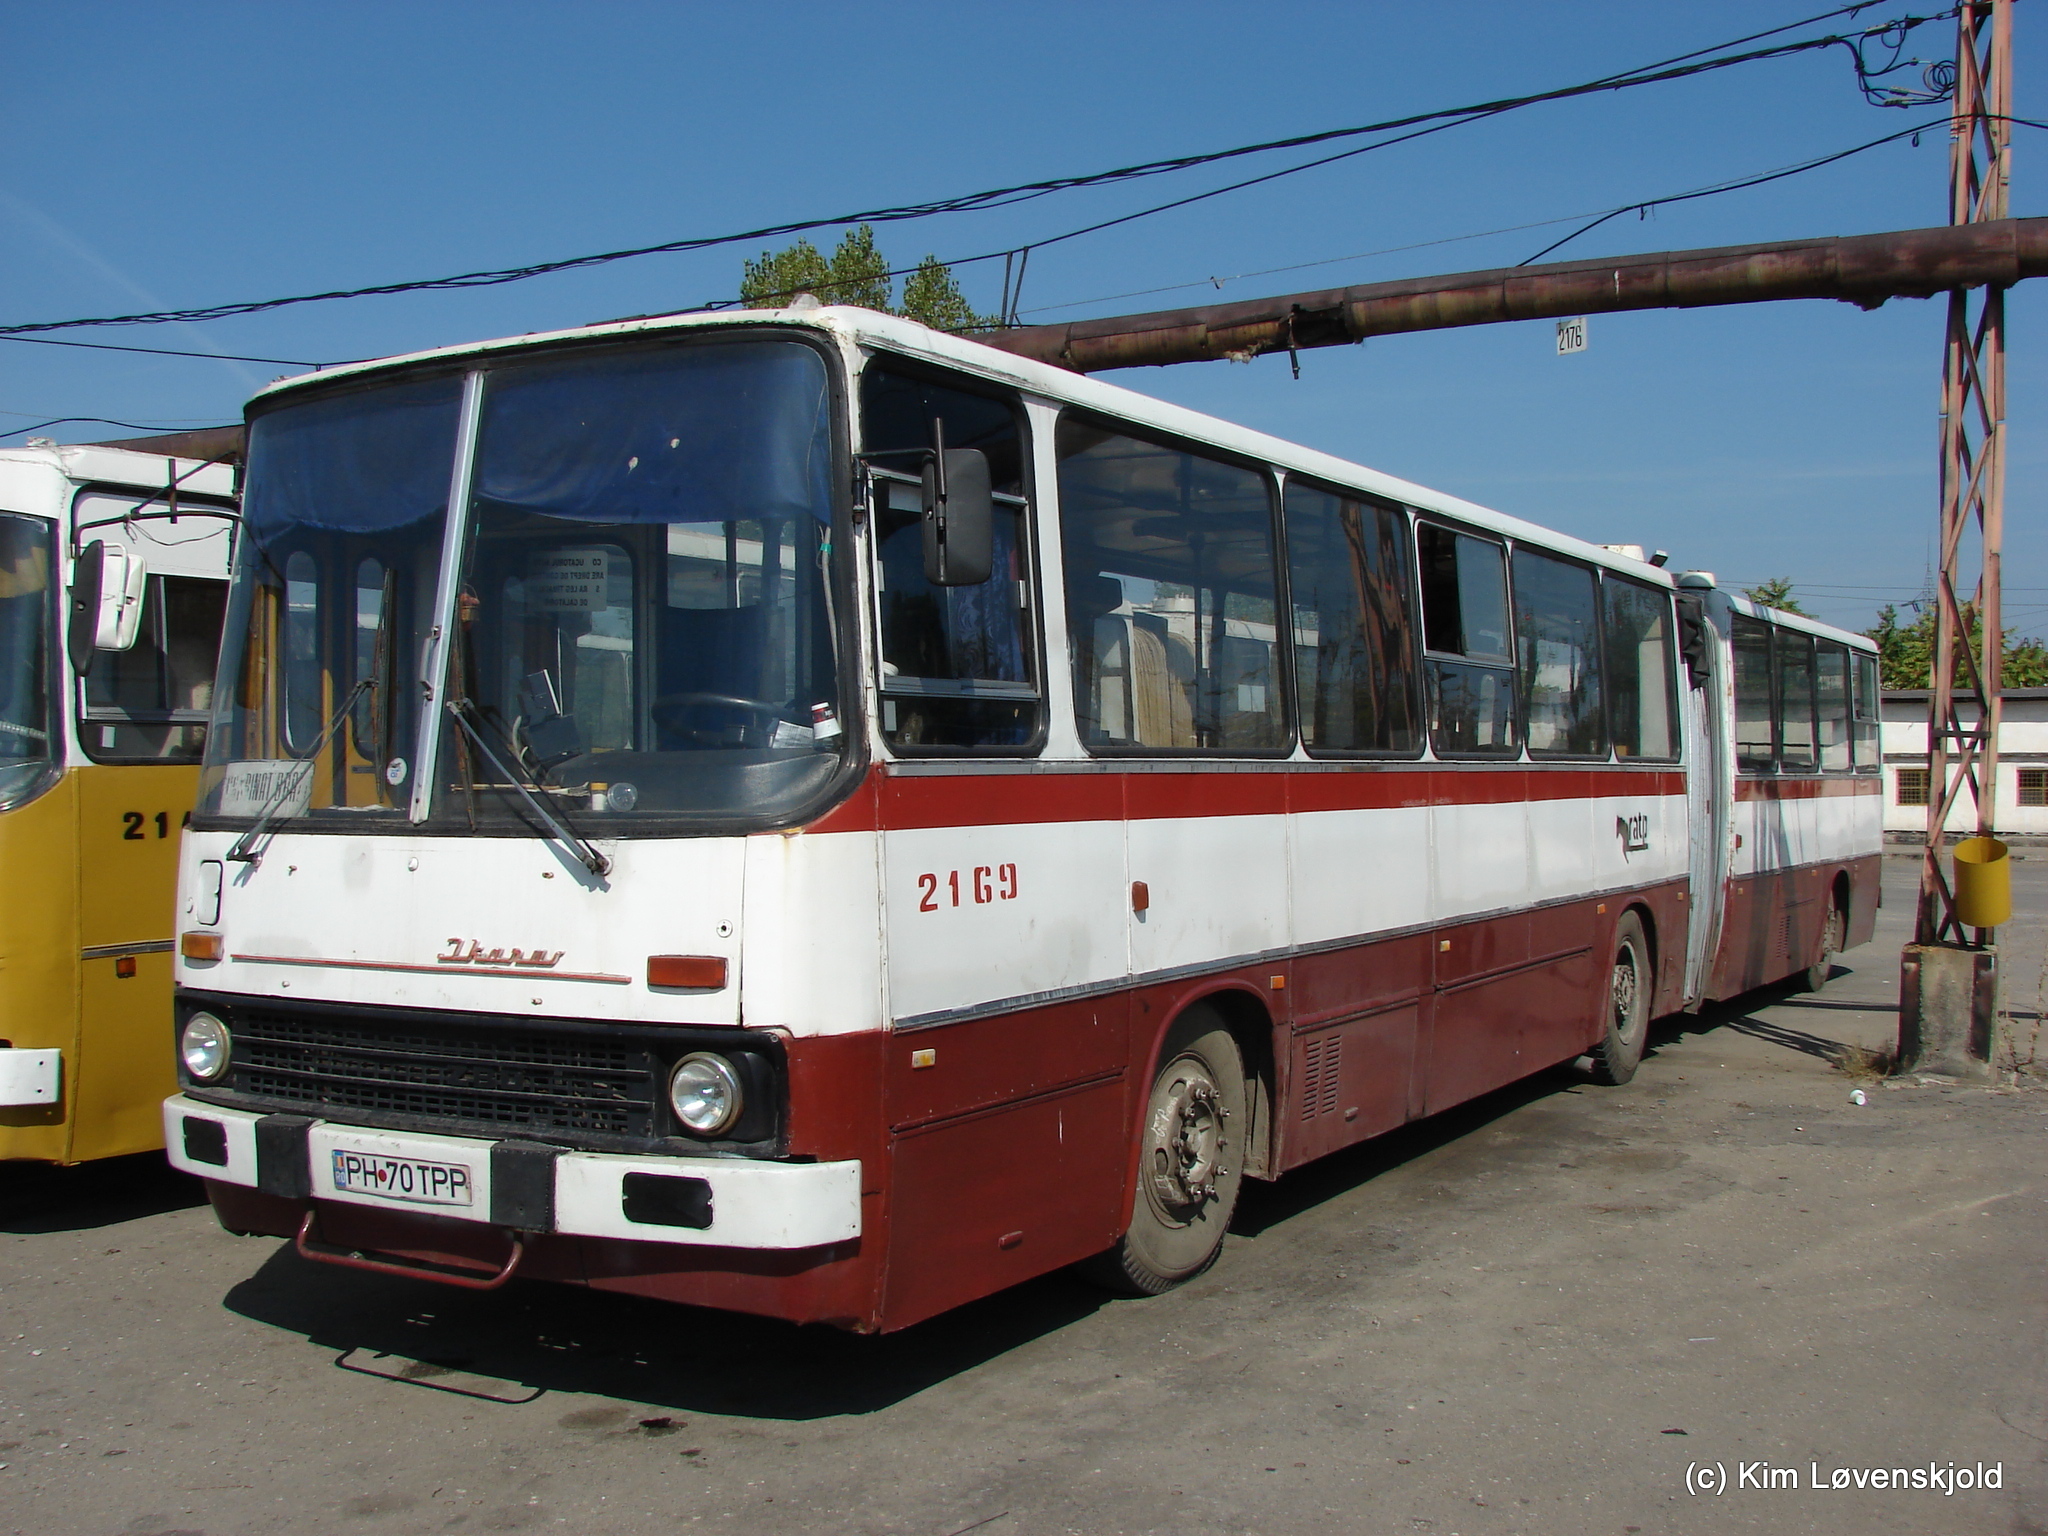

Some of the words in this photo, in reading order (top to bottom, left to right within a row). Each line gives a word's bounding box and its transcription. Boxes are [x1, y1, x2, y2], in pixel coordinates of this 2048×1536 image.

[1559, 325, 1582, 351] 2176
[918, 863, 1017, 913] 2169
[437, 938, 565, 968] Ikarus
[346, 1156, 378, 1188] PH
[417, 1165, 467, 1198] TPP
